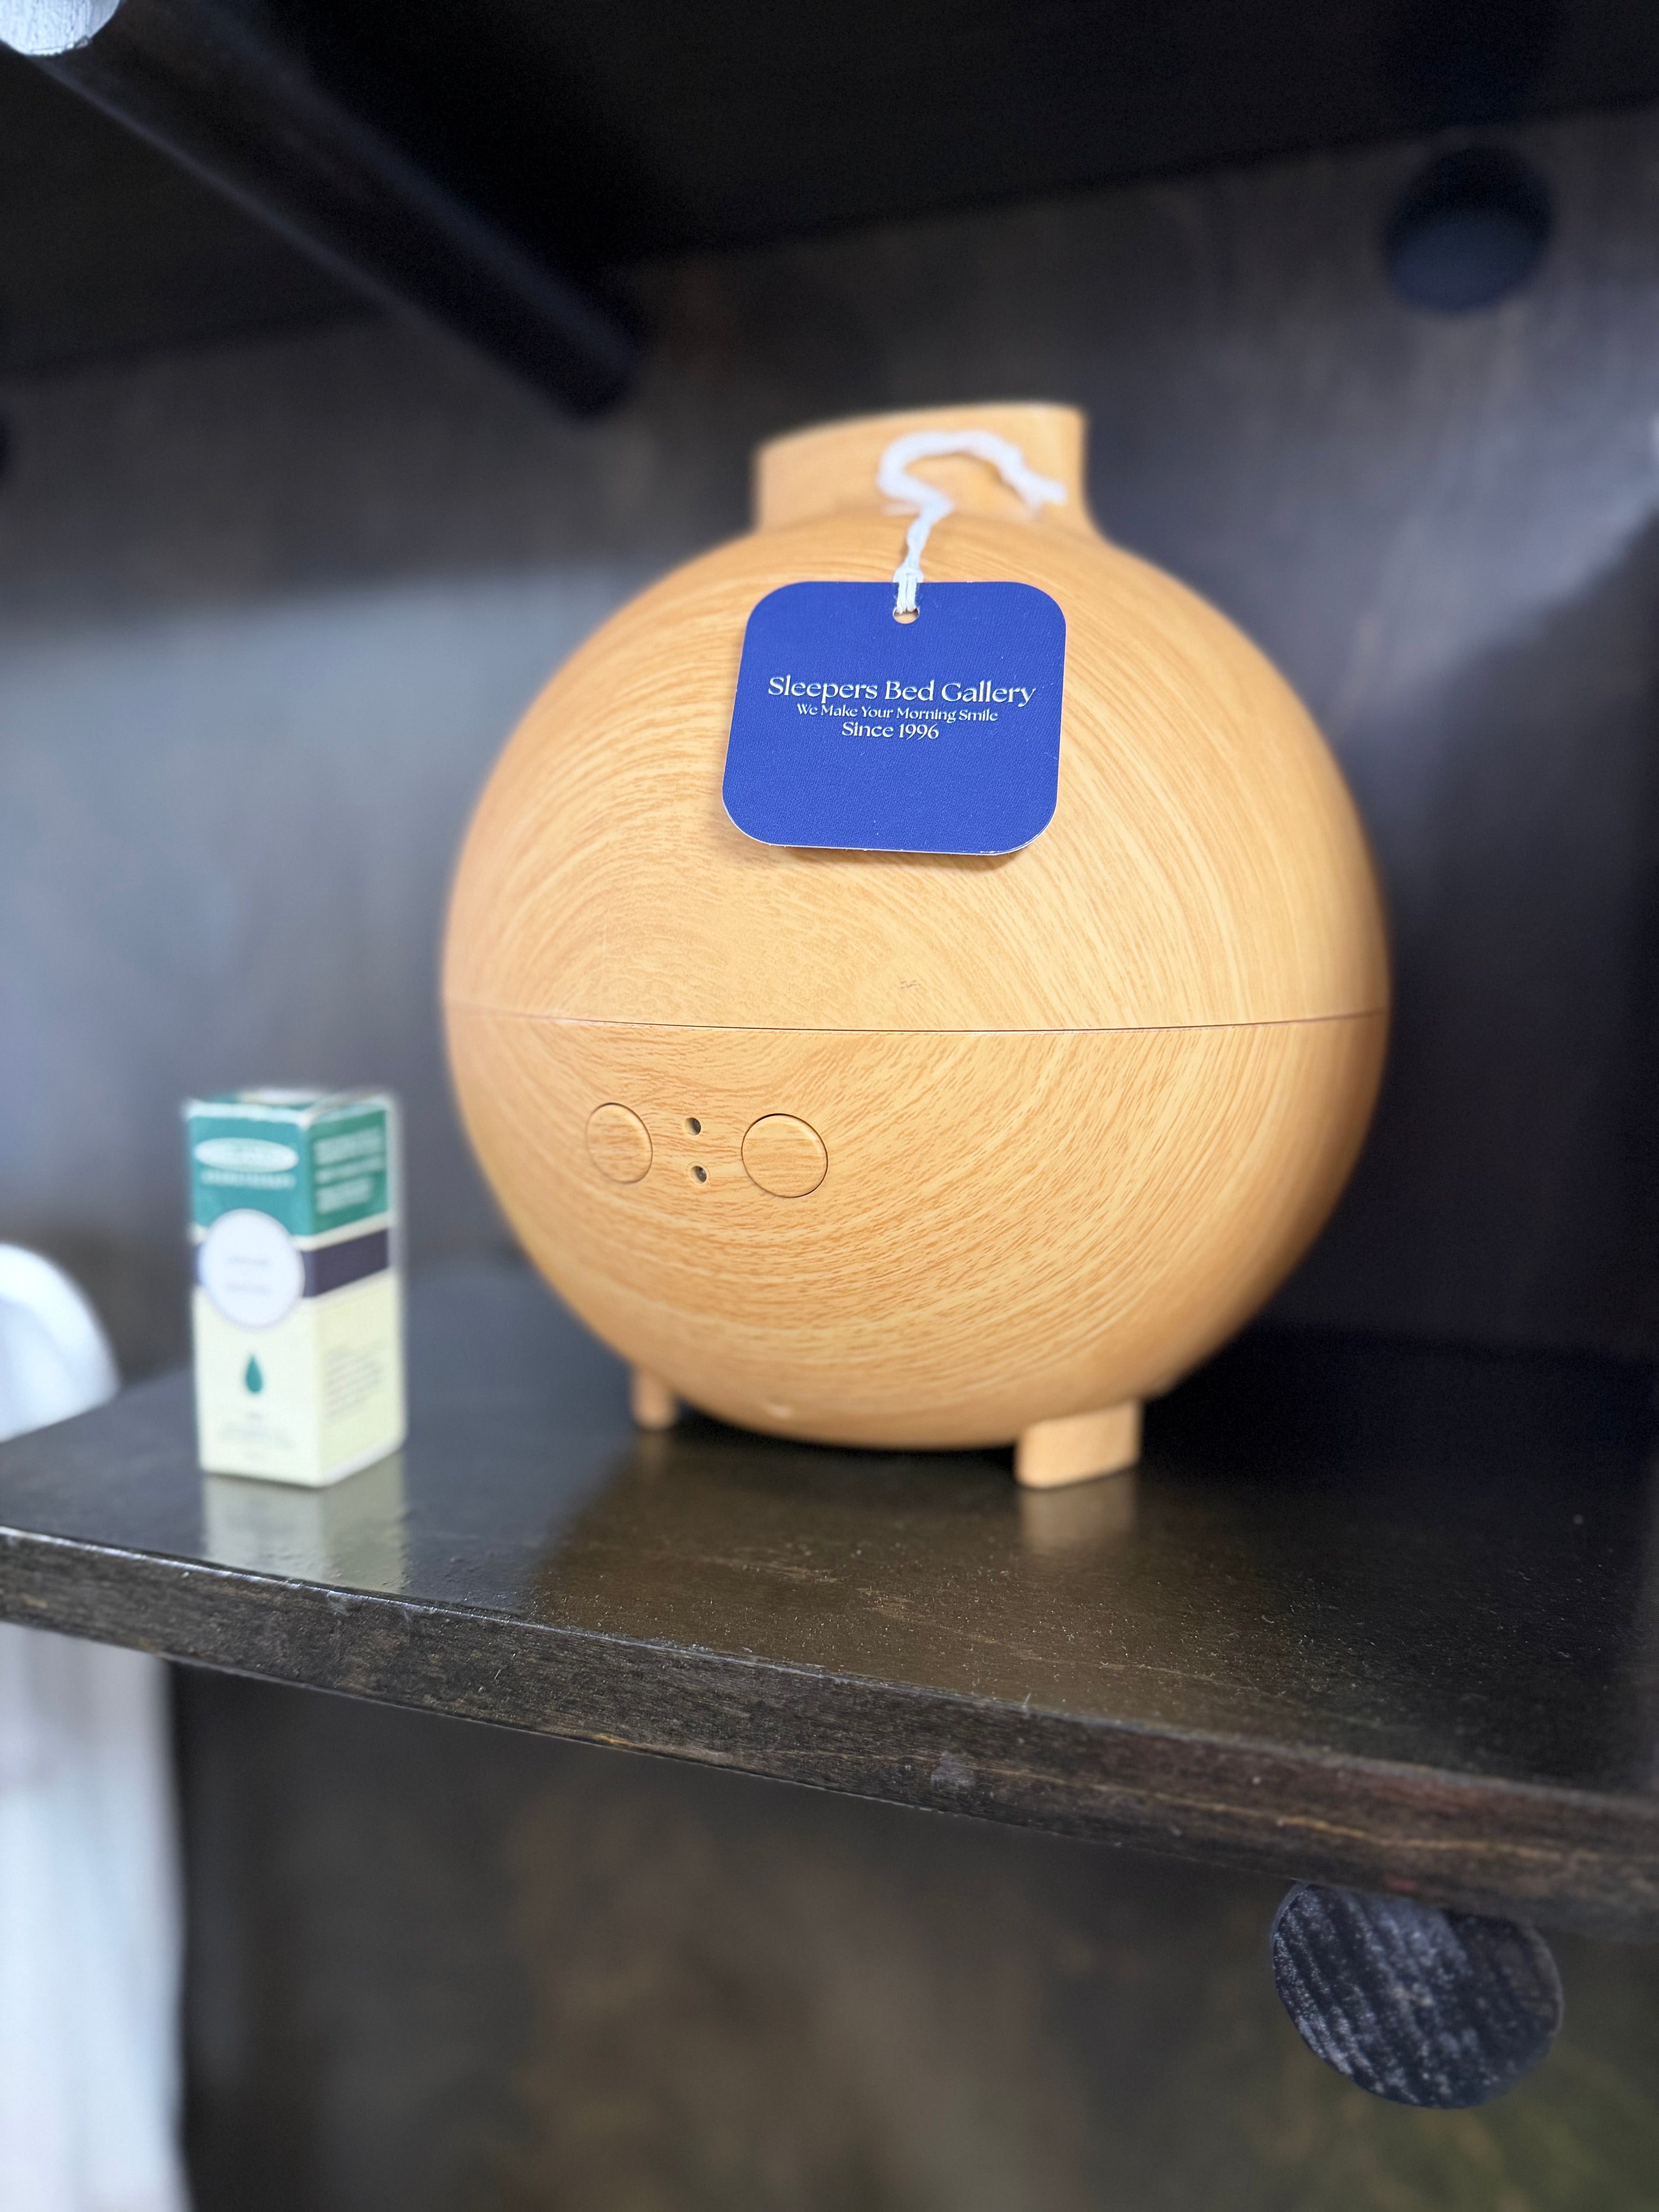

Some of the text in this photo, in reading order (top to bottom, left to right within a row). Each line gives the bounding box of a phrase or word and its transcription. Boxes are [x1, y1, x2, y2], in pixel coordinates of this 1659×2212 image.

[768, 674, 1036, 707] Sleepers Bed Gallery
[797, 703, 998, 724] We Make Your Morning Smile
[842, 721, 939, 741] Since 1996
